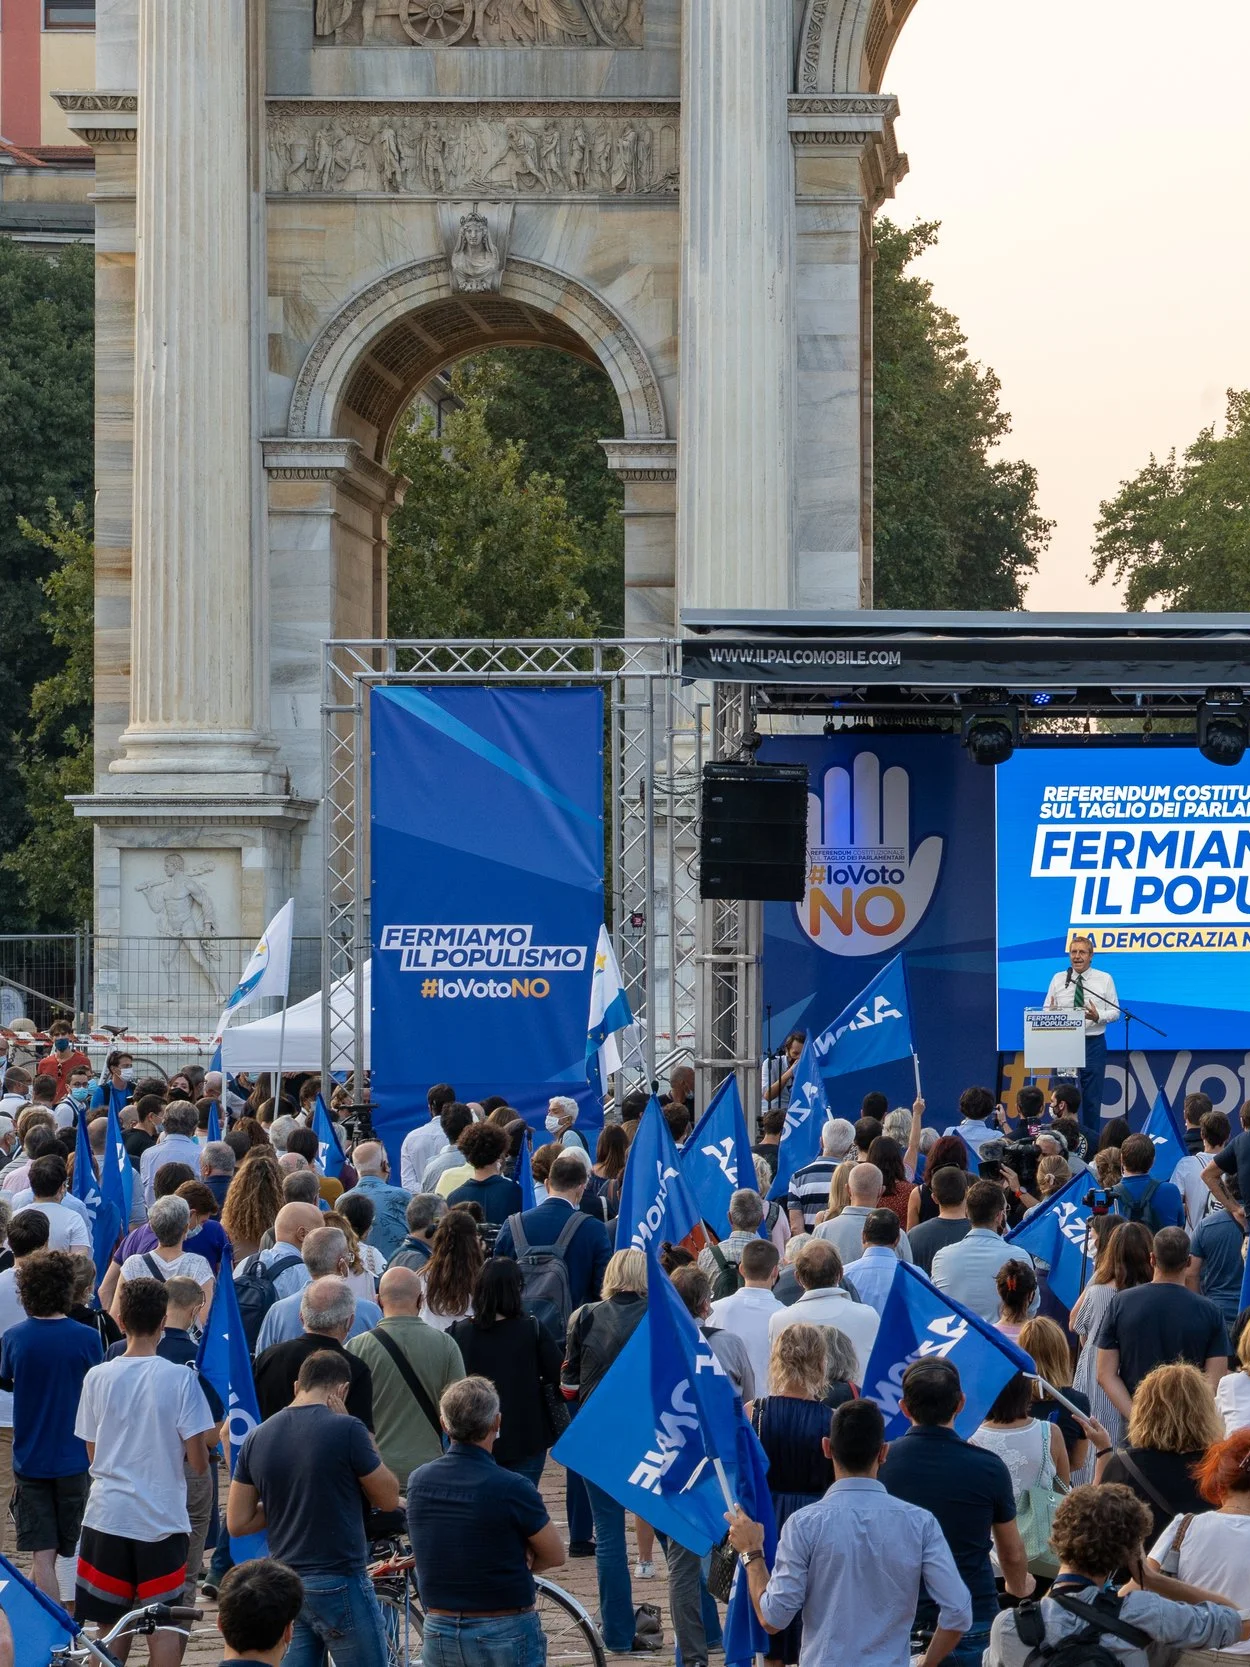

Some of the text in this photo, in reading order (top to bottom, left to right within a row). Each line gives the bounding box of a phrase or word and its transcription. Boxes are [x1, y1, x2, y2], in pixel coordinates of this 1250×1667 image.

[709, 648, 900, 665] WWW.ILPALCOMOBILE.COM
[1043, 786, 1170, 802] REFERENDUM
[1039, 802, 1076, 819] SUL
[1079, 802, 1146, 818] TAGLIO
[1149, 802, 1181, 818] DEI
[809, 865, 905, 885] #IoVoto
[1081, 876, 1122, 915] IL
[809, 886, 906, 937] NO
[385, 927, 527, 947] FERMIAMO
[1101, 932, 1237, 949] DEMOCRAZIA
[405, 948, 582, 968] IL POPULISMO
[421, 977, 550, 998] #IoVotoNO
